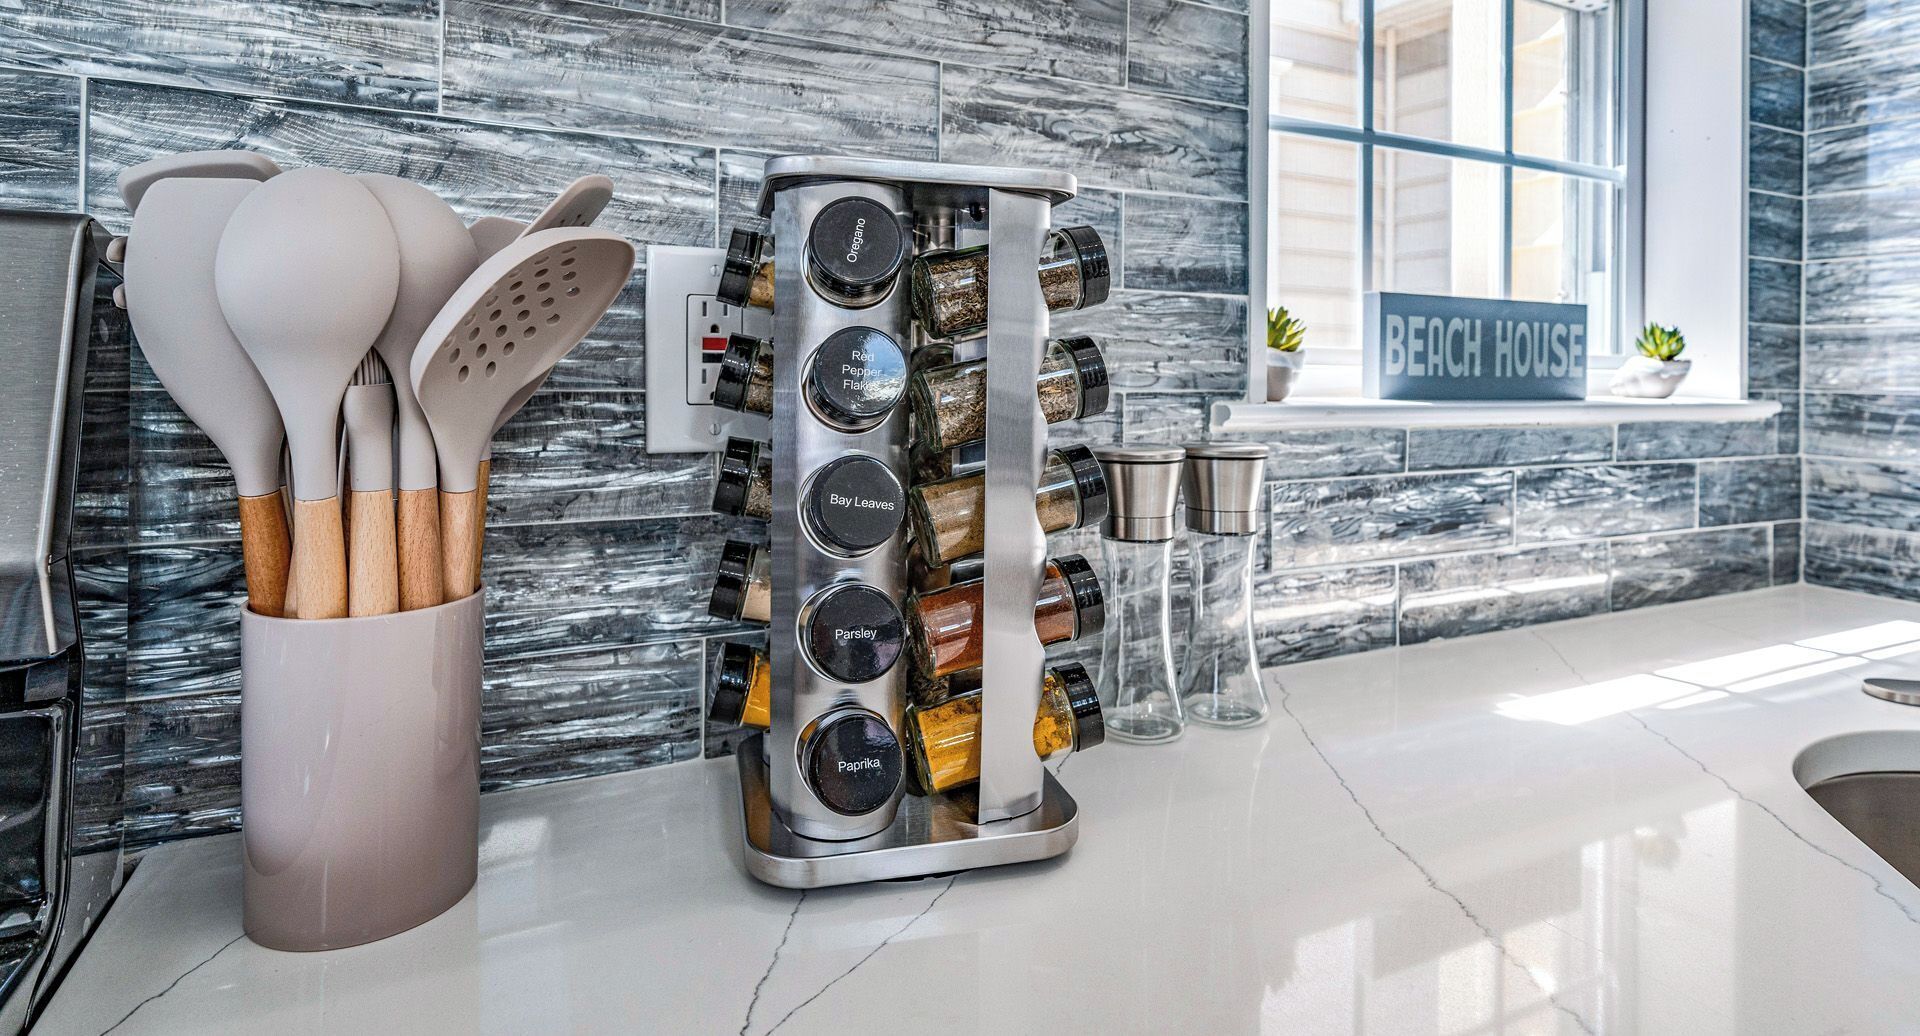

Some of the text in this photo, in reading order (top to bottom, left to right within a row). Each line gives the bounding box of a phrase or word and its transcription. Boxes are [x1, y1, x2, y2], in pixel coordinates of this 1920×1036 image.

[846, 217, 866, 263] Oregano
[1386, 314, 1584, 378] BEACH HOUSE
[852, 350, 875, 362] Red
[841, 365, 882, 378] Pepper
[843, 379, 877, 391] Flak
[830, 493, 895, 511] Bay Leaves
[835, 628, 877, 641] Parsley
[838, 757, 880, 773] Paprika
